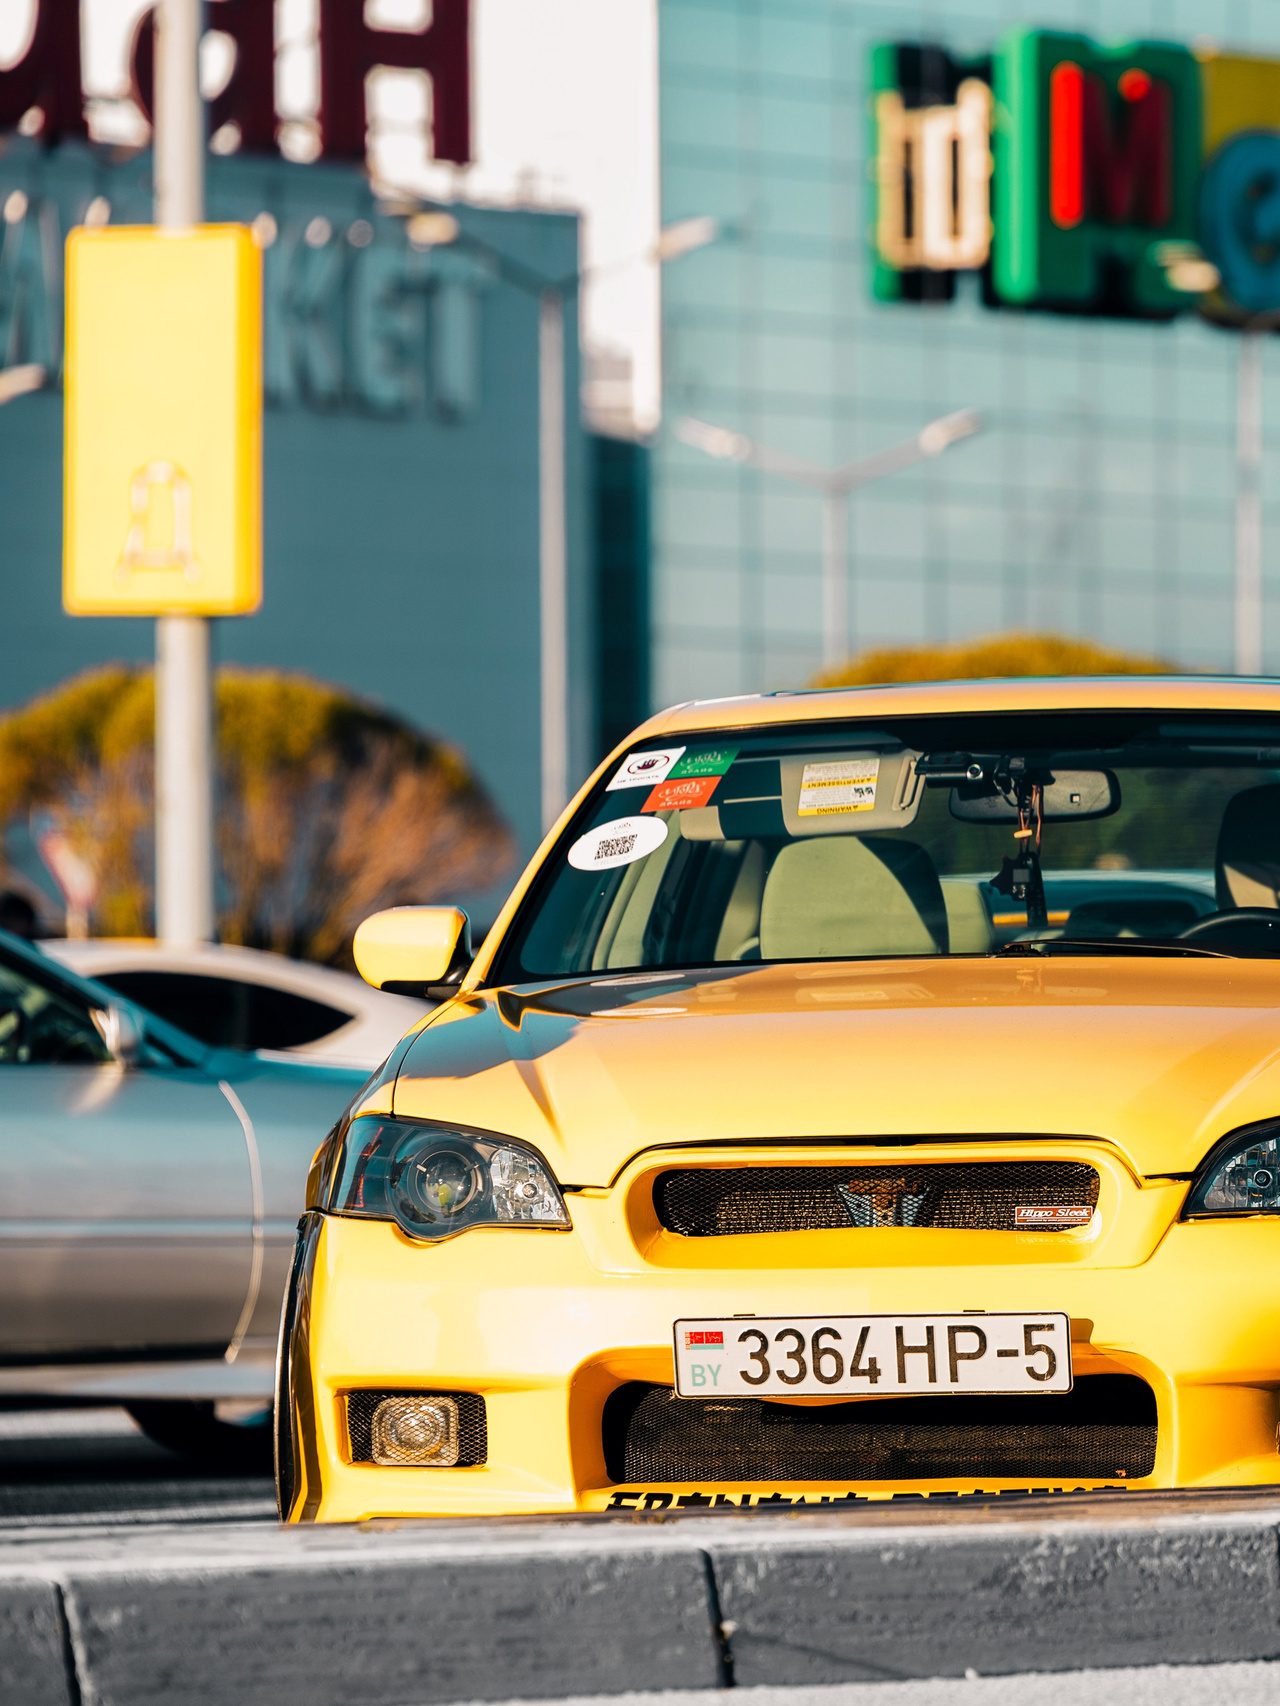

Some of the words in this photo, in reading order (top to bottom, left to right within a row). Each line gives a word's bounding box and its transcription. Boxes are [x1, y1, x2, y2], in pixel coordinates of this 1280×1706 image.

[816, 805, 851, 815] WARNING
[1018, 1208, 1053, 1219] Hippo
[1056, 1208, 1090, 1217] Sleek
[691, 1364, 721, 1386] BY
